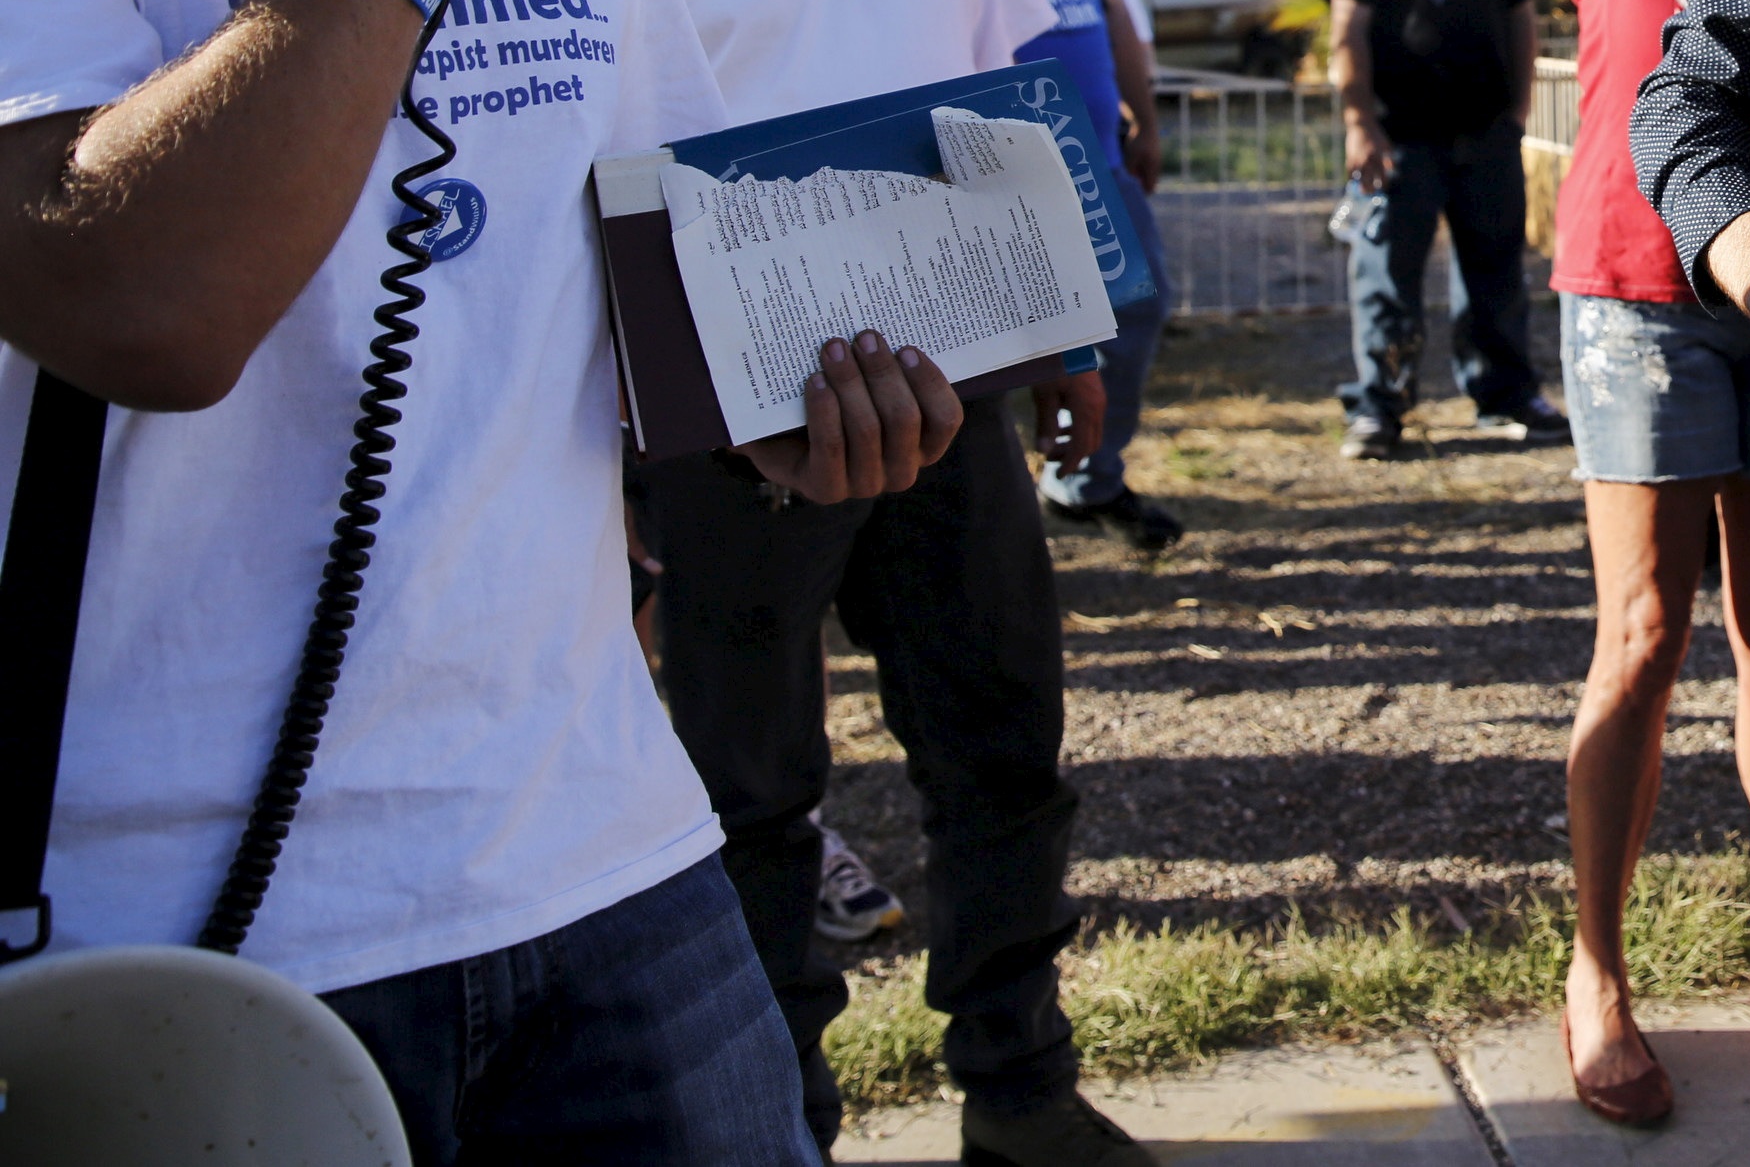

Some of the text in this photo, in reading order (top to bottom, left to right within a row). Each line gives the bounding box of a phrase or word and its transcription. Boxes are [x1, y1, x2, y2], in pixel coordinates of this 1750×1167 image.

[416, 37, 489, 81] apist
[450, 75, 584, 124] prophet
[1017, 77, 1107, 282] SACRED
